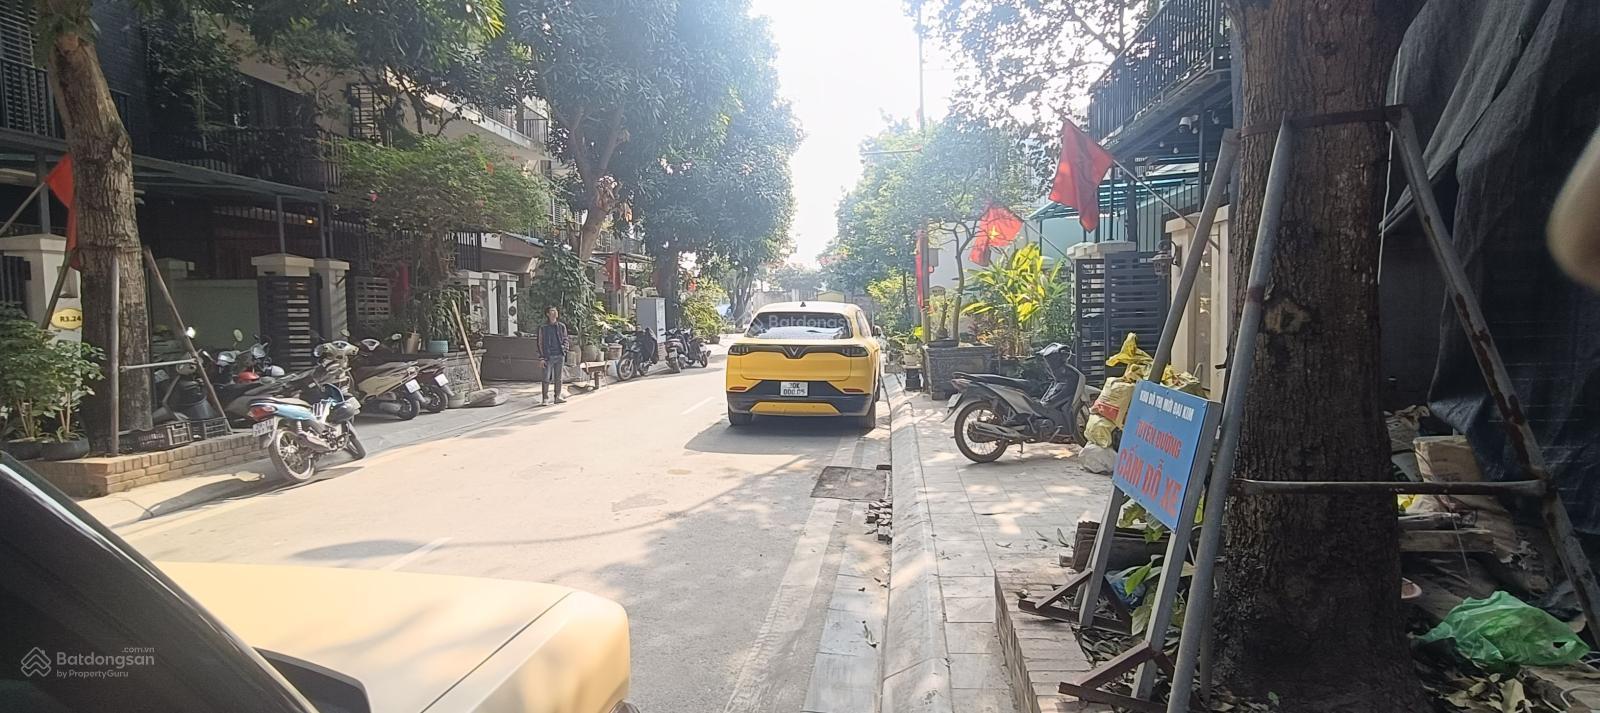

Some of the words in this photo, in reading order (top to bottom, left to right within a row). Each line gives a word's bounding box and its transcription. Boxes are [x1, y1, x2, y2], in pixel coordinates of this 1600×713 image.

[1182, 405, 1194, 422] KIM
[1117, 444, 1144, 487] CẤM
[1141, 458, 1164, 501] ĐỖ
[1160, 475, 1182, 518] XE
